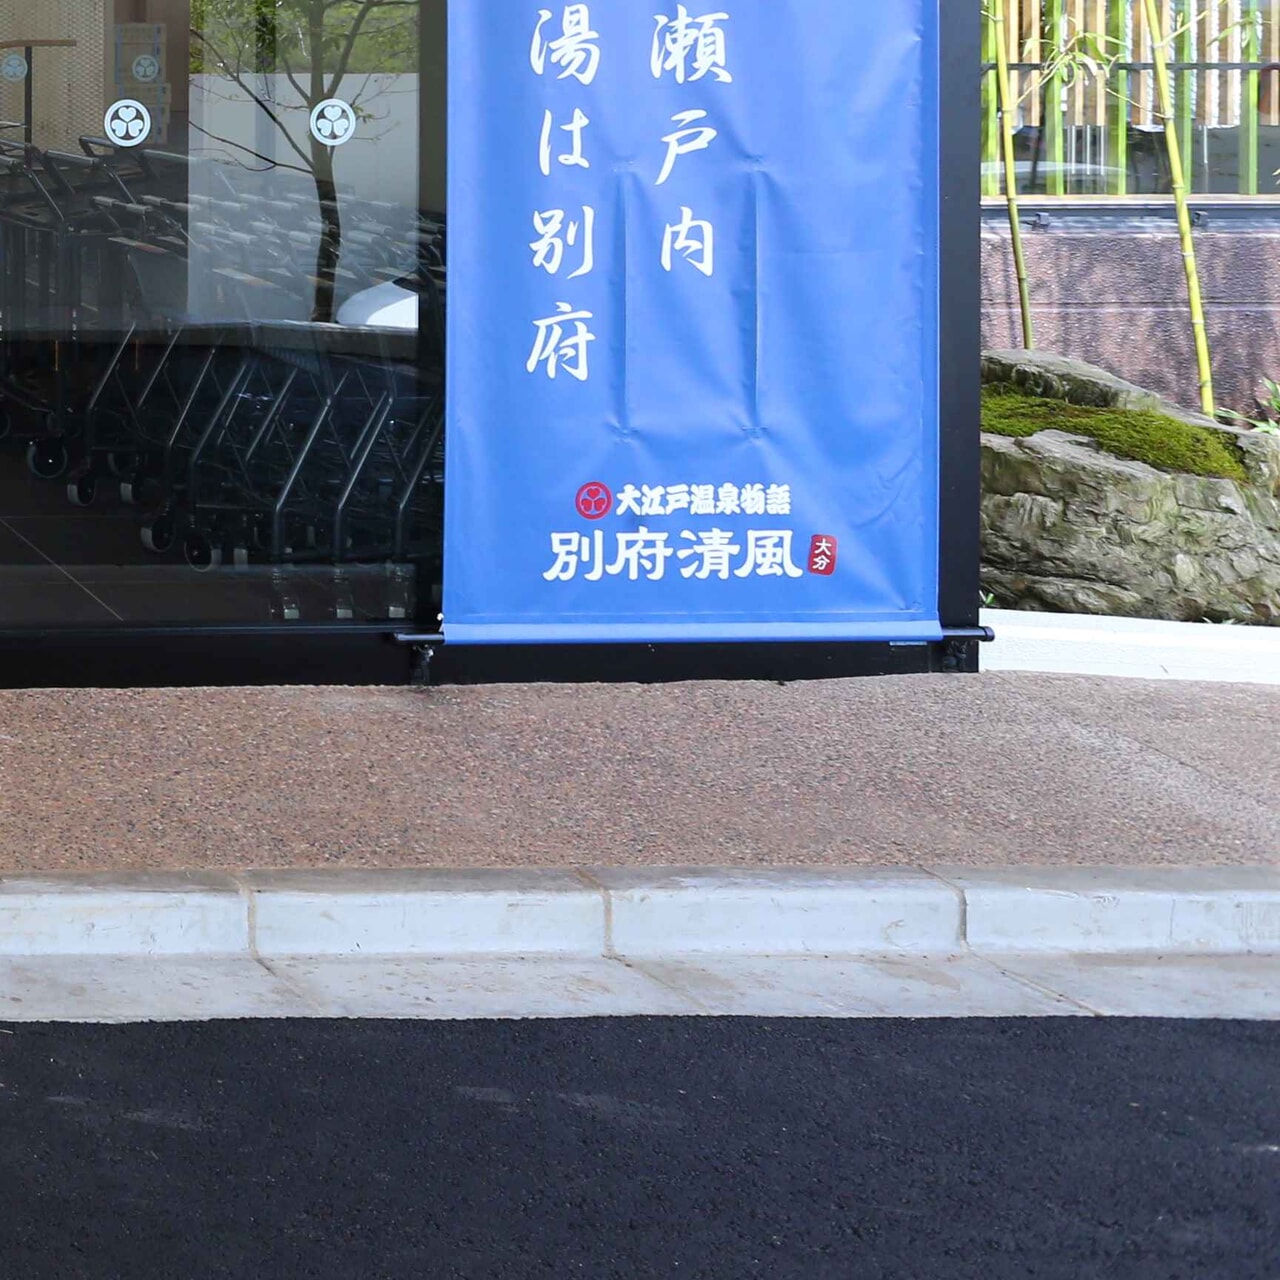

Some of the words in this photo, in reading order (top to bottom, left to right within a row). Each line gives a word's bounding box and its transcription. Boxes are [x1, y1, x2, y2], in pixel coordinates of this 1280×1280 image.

[526, 3, 601, 382] 湯は別府
[616, 482, 792, 516] 大江戸温泉物語
[542, 526, 804, 581] 別府清風
[812, 537, 832, 571] 大分
